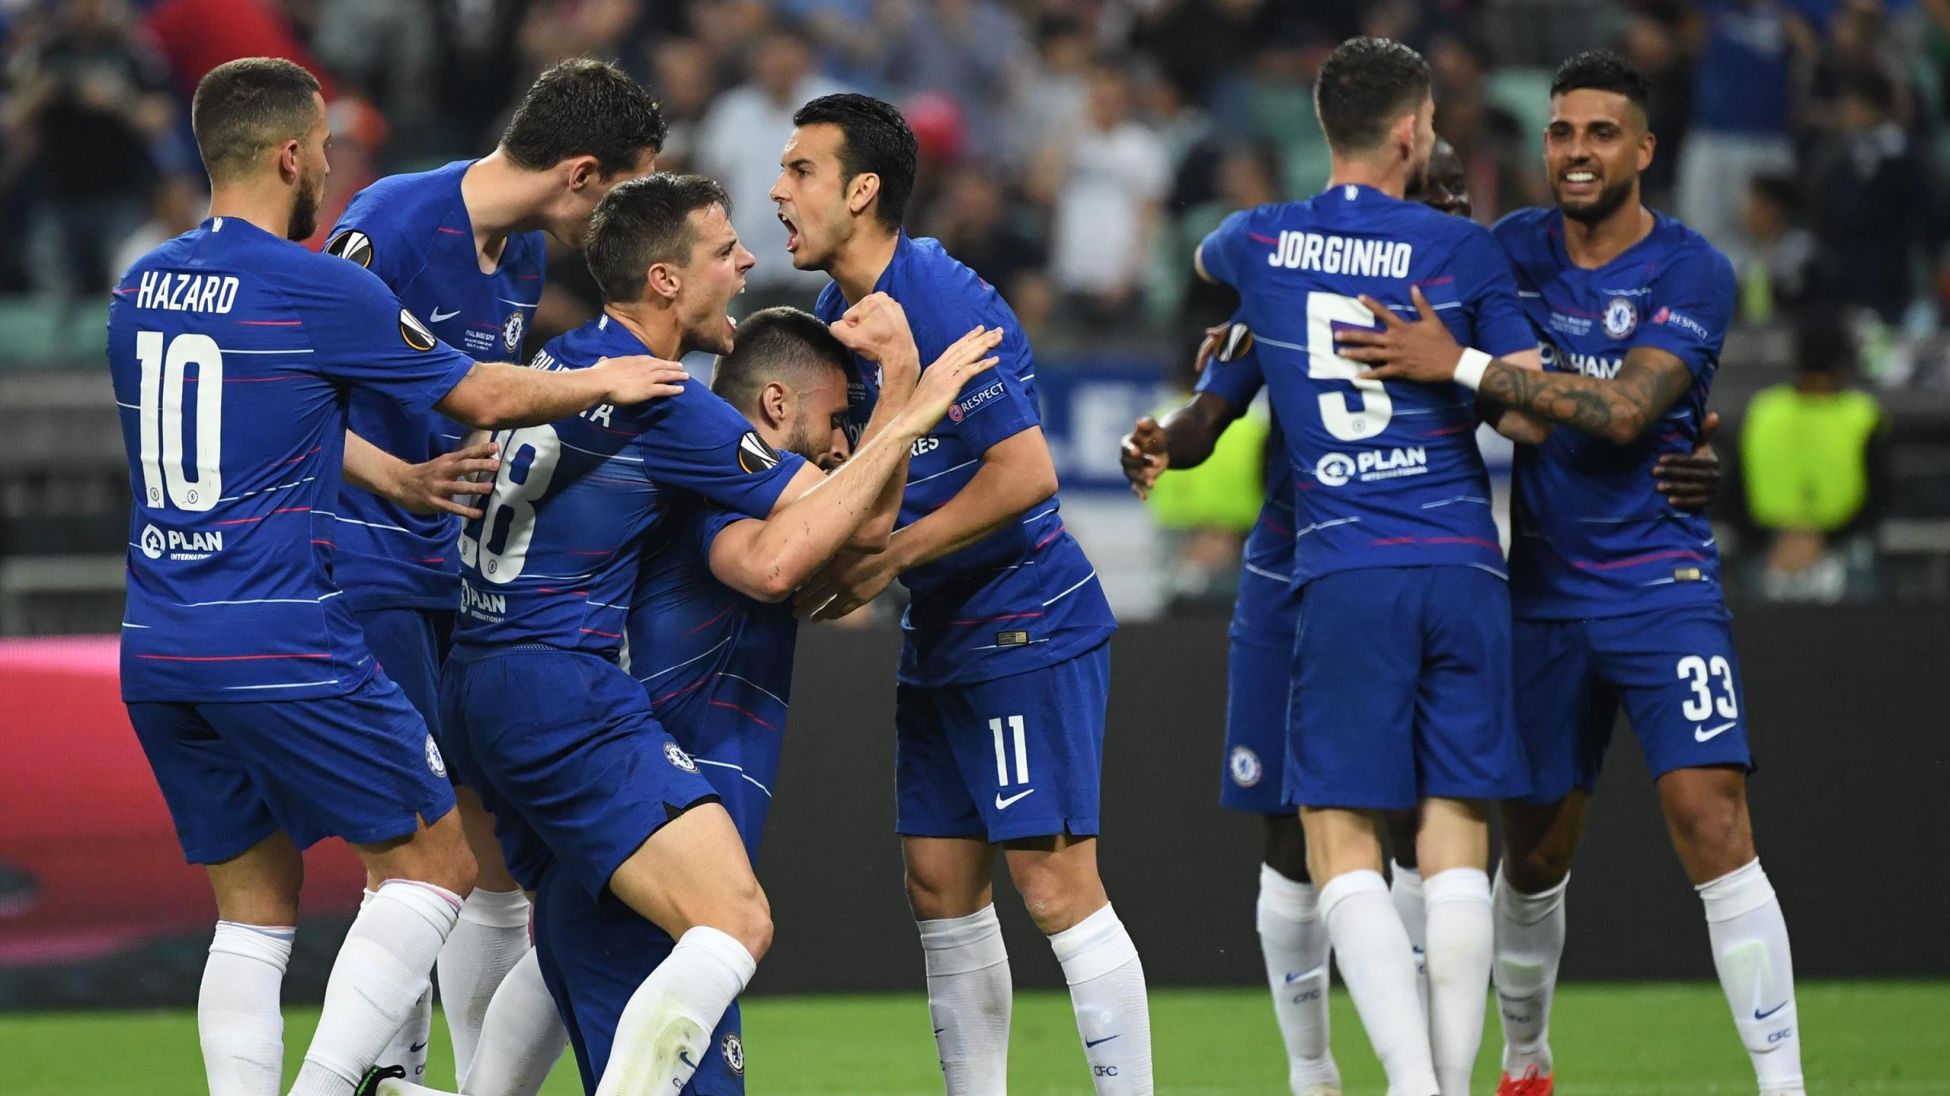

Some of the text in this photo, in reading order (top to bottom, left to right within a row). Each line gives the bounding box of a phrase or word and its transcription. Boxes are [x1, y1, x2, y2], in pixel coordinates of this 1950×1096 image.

[1268, 230, 1412, 279] JORGINHO
[136, 271, 240, 314] HAZARD
[1306, 291, 1393, 441] 5
[960, 382, 1004, 412] RESPECT
[136, 331, 223, 512] 10
[910, 437, 939, 458] RES
[1357, 446, 1427, 473] PLAN
[167, 530, 223, 552] PLAN
[470, 587, 506, 614] PLAN
[1677, 655, 1738, 721] 33
[988, 715, 1029, 787] 11
[1094, 1065, 1118, 1077] CFC
